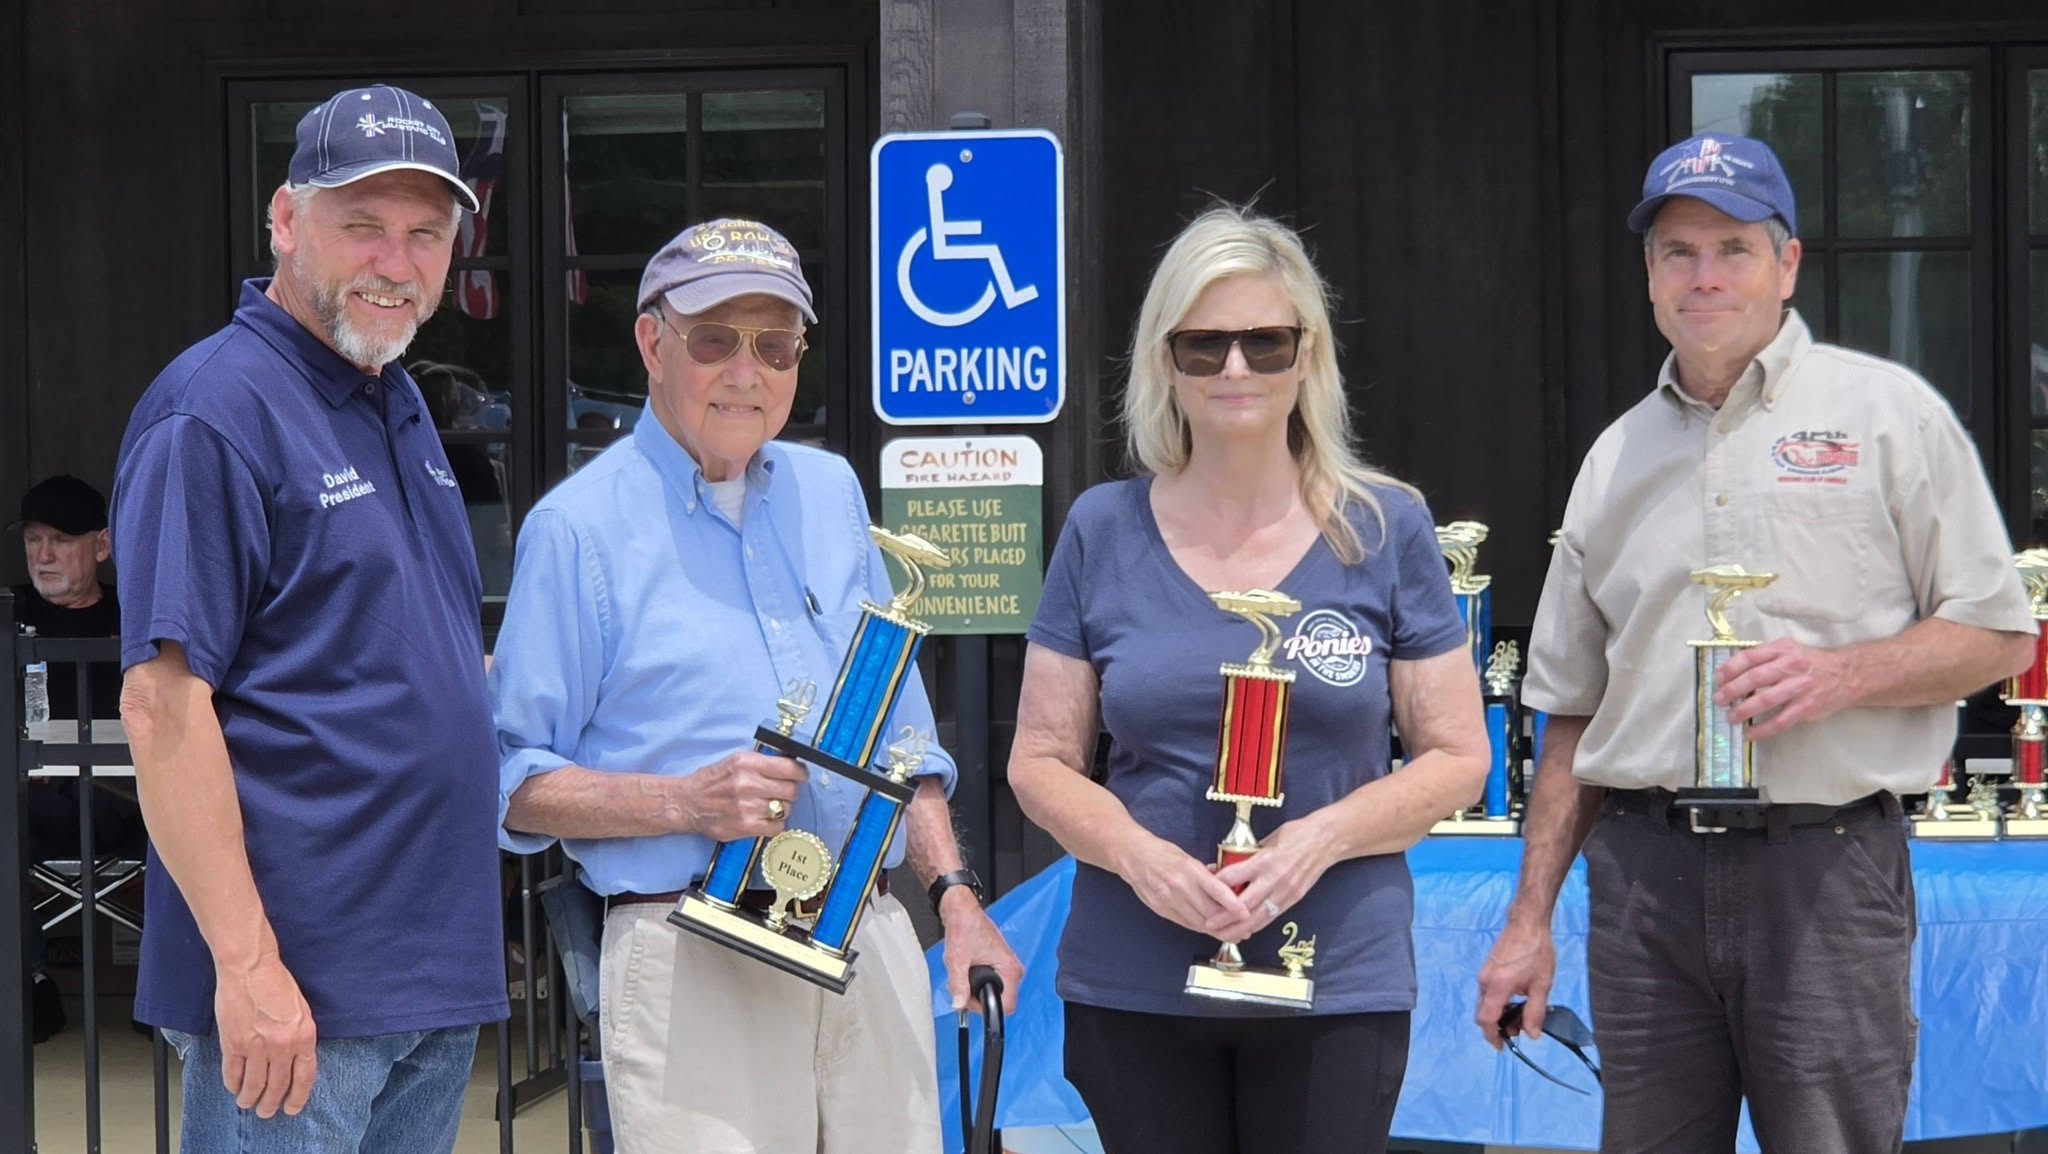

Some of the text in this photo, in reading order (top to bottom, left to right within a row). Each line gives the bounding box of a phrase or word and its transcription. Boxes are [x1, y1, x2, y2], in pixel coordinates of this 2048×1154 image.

[382, 123, 428, 134] MUSTANG
[387, 117, 424, 127] ROCKET
[890, 345, 1048, 393] PARKING
[900, 449, 1018, 469] CAUTION
[322, 466, 360, 489] David
[905, 472, 1012, 483] FIRE HAZARD
[319, 480, 377, 509] President
[907, 499, 1003, 518] PLEASE USE
[990, 523, 1027, 543] BUTT
[974, 548, 1026, 566] PLACED
[929, 573, 1000, 589] FOR YOUR
[906, 595, 1021, 616] ONVENIENCE
[1283, 630, 1373, 660] Ponies
[791, 850, 807, 864] 1st
[778, 861, 809, 882] Place
[1277, 921, 1316, 957] 2nd
